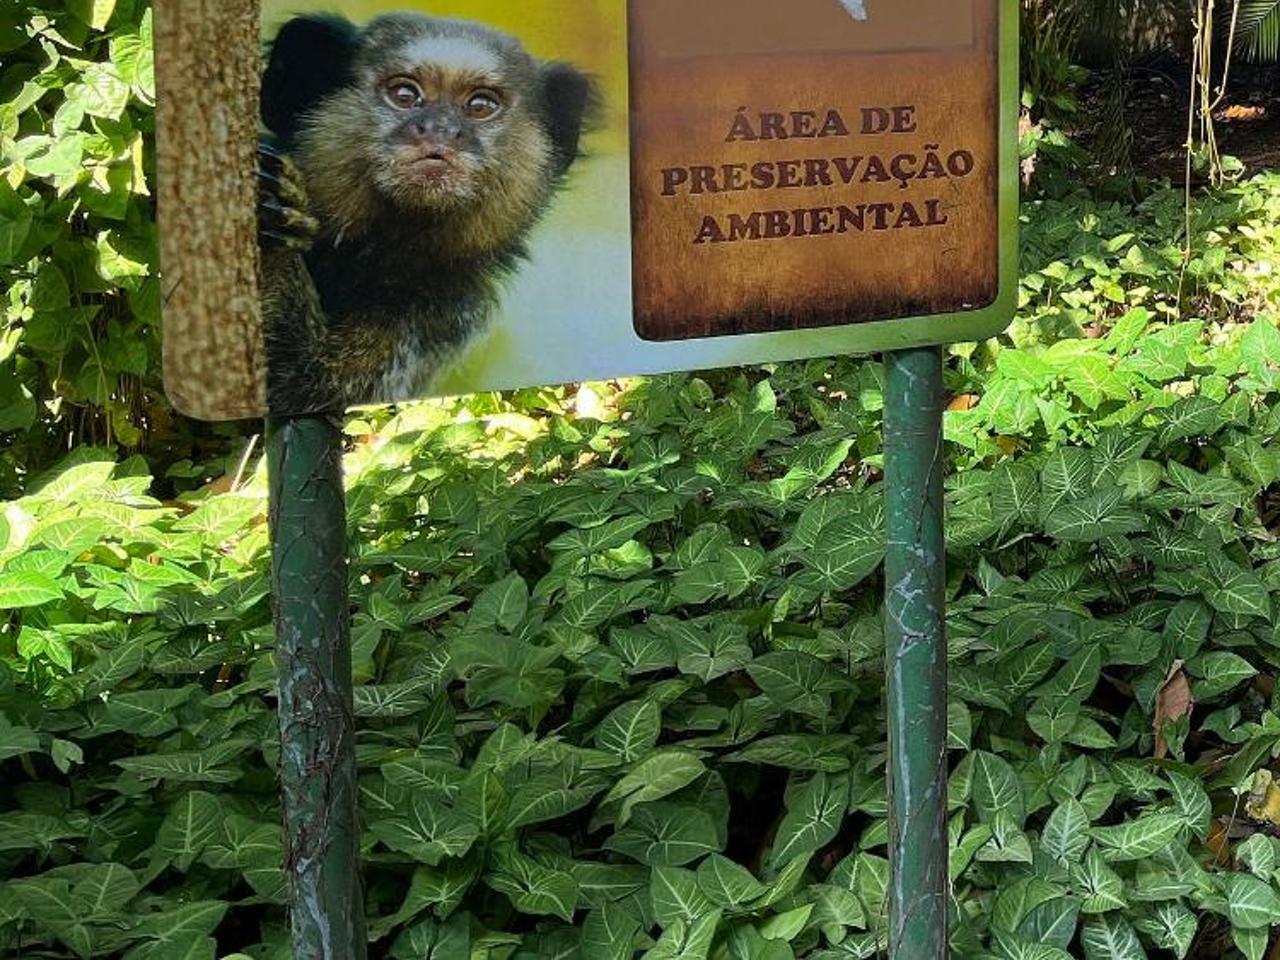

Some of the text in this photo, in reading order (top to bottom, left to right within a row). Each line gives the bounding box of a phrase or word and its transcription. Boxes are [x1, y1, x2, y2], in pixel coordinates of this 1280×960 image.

[727, 106, 915, 141] ÁREA DE
[661, 144, 974, 196] PRESERVAÇÃO
[695, 199, 948, 244] AMBIENTAL
